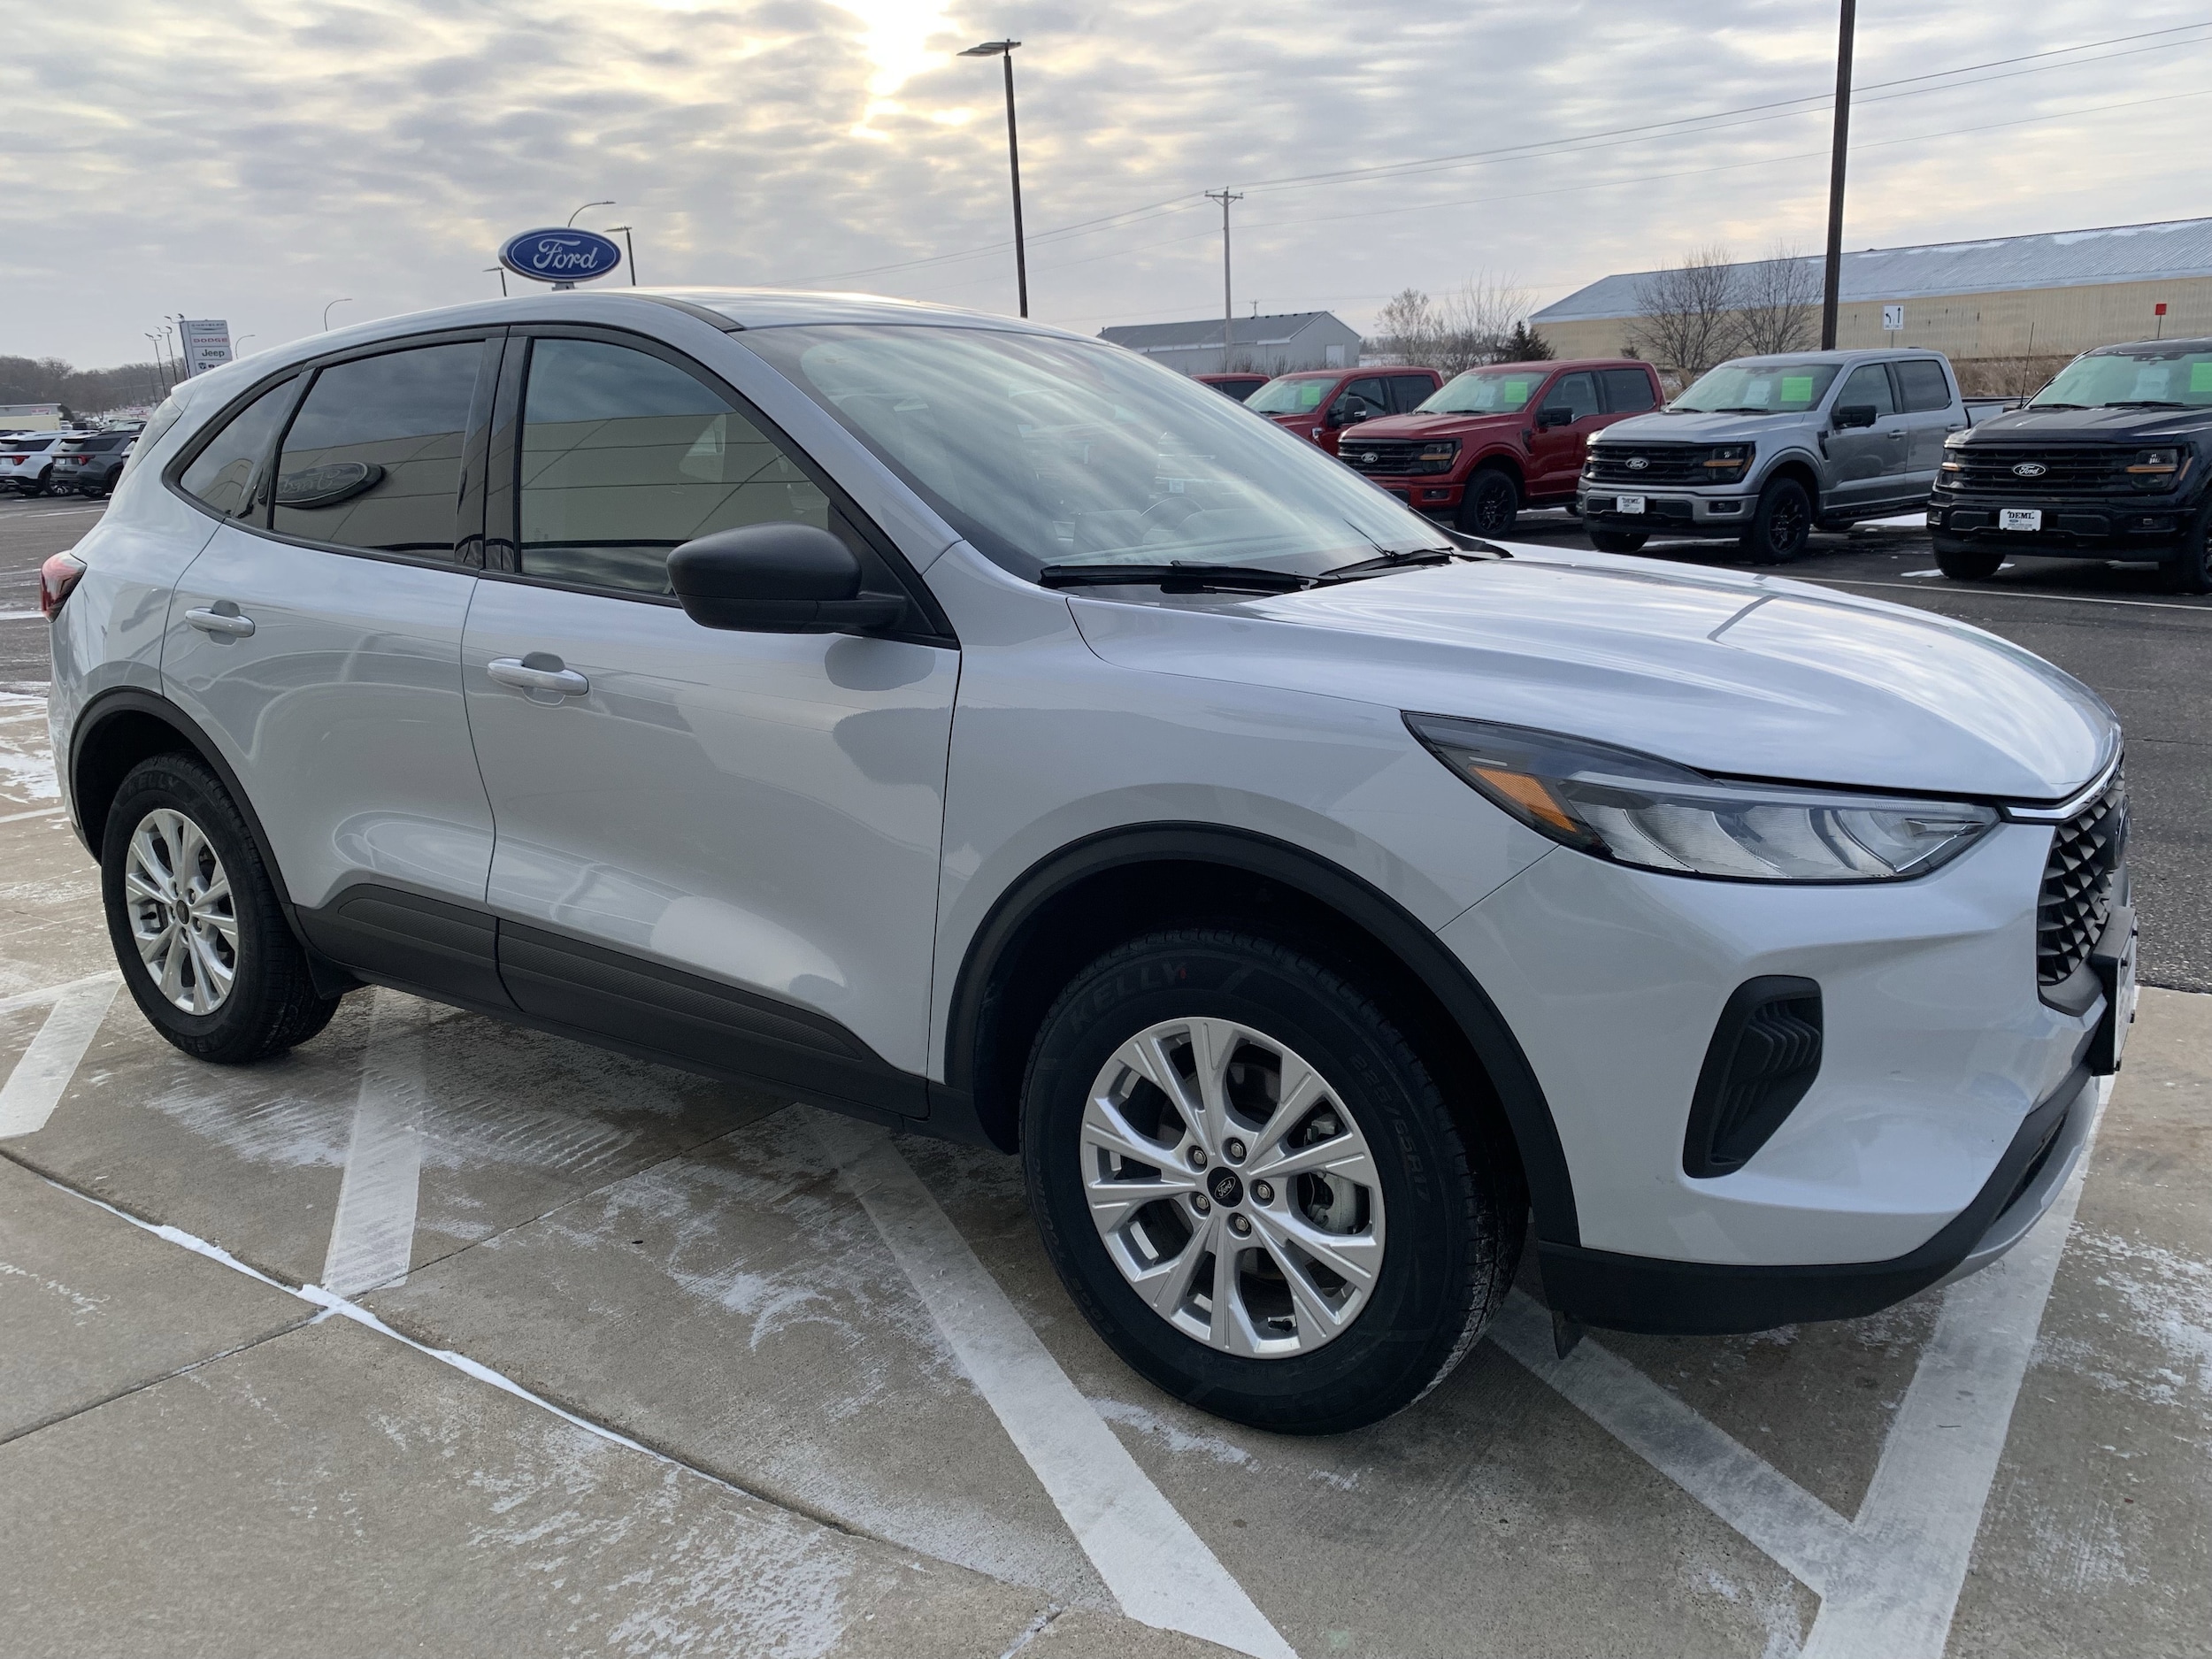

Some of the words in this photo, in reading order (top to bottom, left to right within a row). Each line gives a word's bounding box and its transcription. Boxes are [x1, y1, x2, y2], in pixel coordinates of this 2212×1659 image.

[533, 238, 598, 269] Ford
[202, 349, 225, 357] Jeep
[2018, 465, 2039, 474] Ford
[2007, 511, 2034, 519] DEML
[1069, 961, 1187, 1034] KELLY
